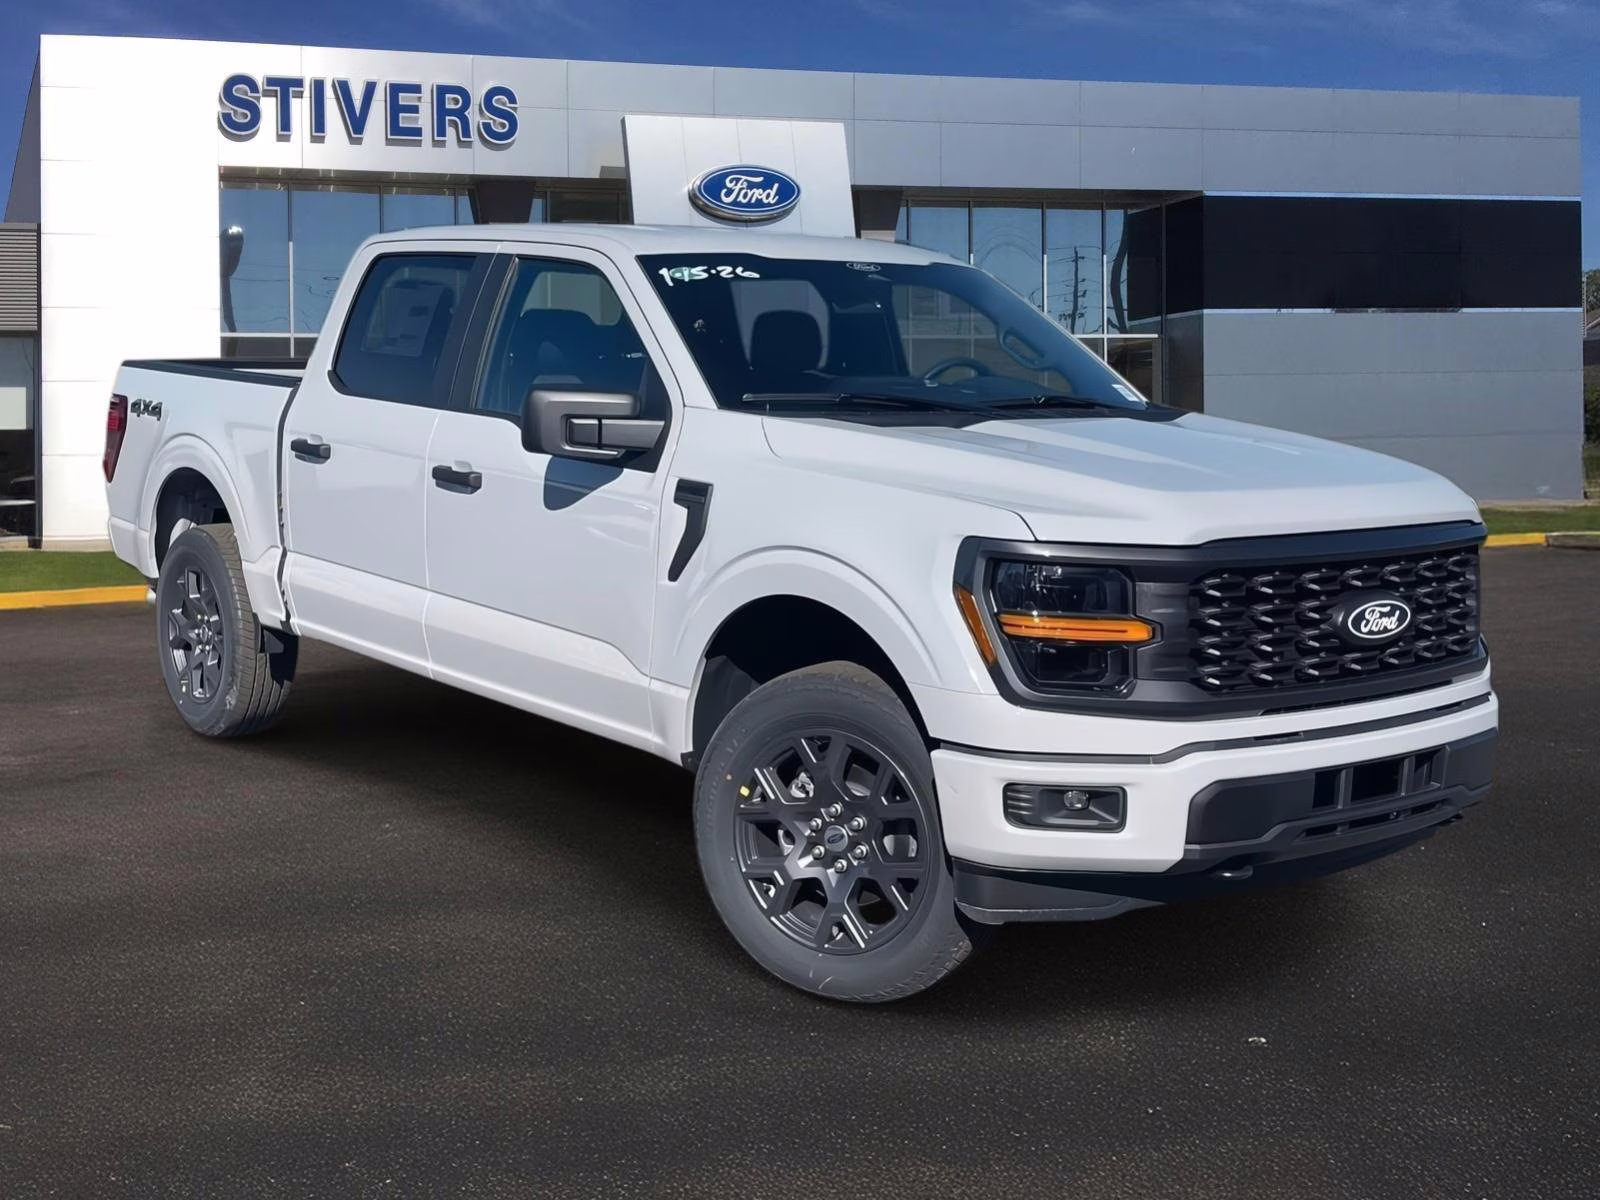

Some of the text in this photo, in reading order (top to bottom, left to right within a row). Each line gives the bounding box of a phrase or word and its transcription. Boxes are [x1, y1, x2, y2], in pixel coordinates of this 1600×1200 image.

[217, 73, 520, 147] STIVERS
[720, 174, 779, 204] Ford
[1360, 605, 1400, 633] Ford
